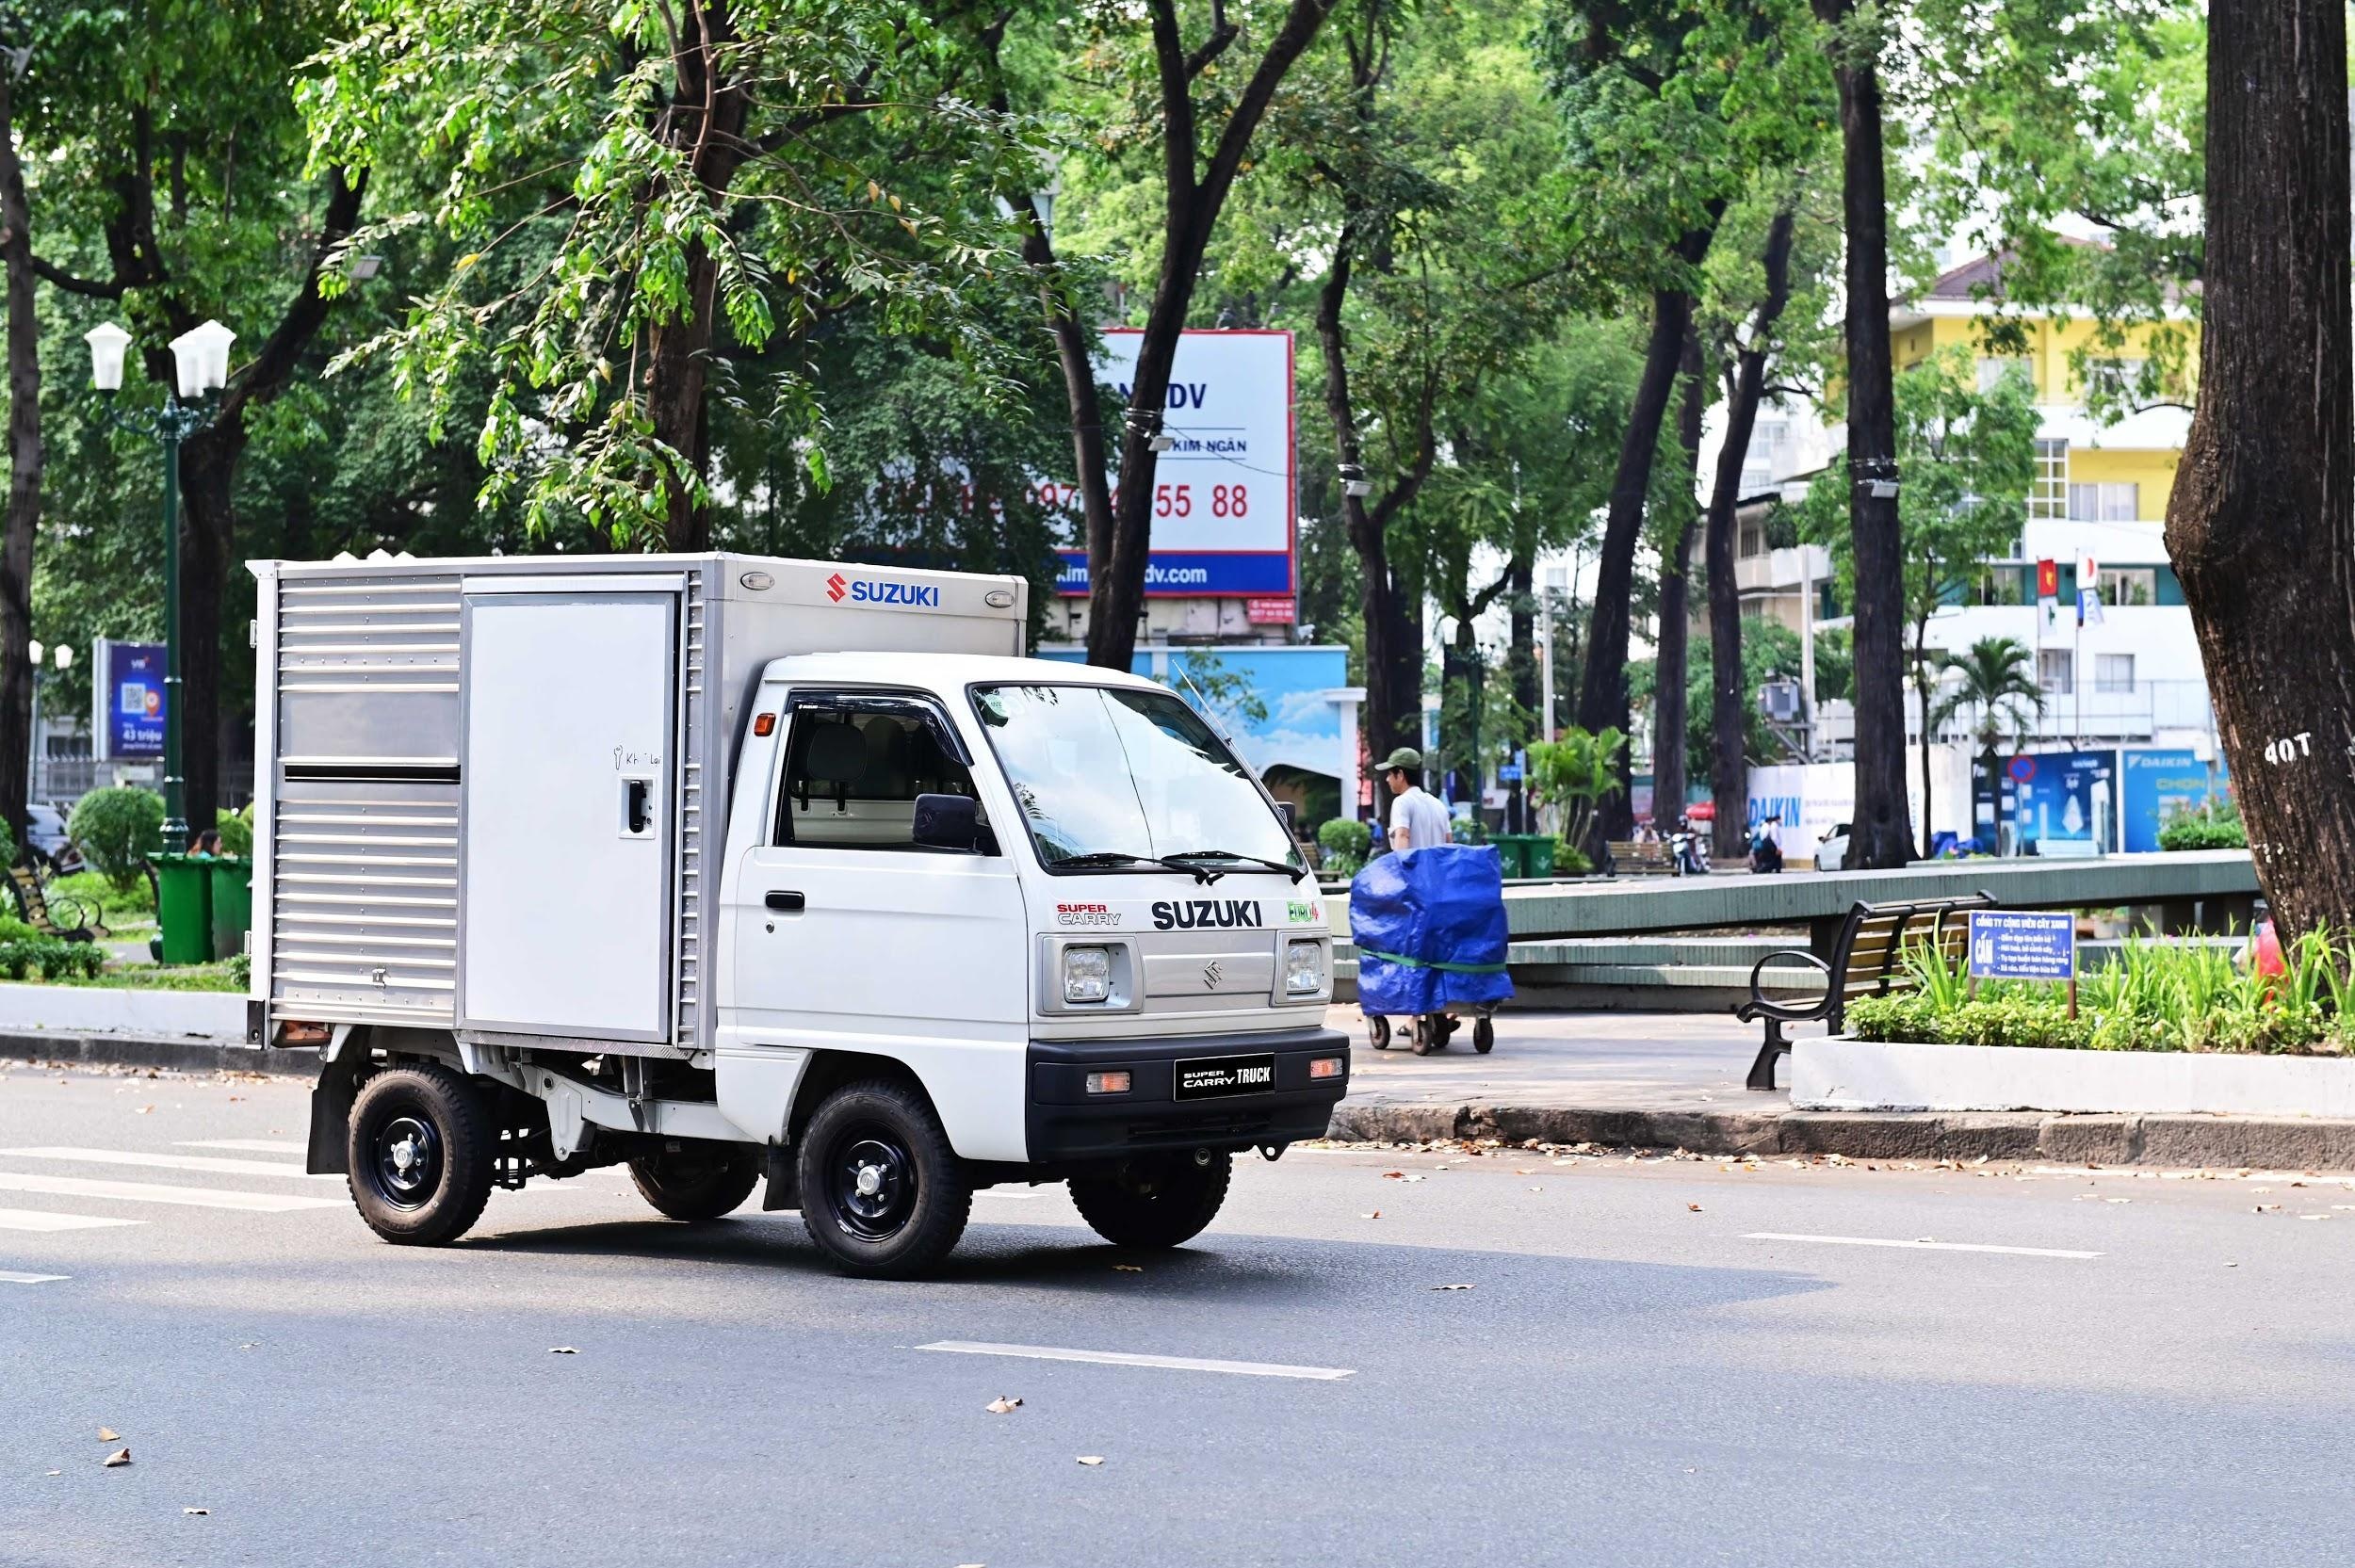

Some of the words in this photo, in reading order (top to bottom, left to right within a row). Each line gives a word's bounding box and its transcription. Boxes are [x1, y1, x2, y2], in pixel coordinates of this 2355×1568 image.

[1173, 440, 1201, 452] KIM
[1156, 484, 1191, 517] 55
[1212, 484, 1248, 517] 88
[852, 580, 938, 607] SUZUKI
[1749, 798, 1800, 827] DAIKIN
[1057, 904, 1107, 913] SUPER
[1151, 900, 1262, 929] SUZUKI
[1058, 913, 1121, 925] CARRY
[1994, 917, 2002, 927] TY
[1183, 1070, 1225, 1079] SUPER
[1183, 1076, 1236, 1088] CARRY
[1237, 1066, 1272, 1084] TRUCK
